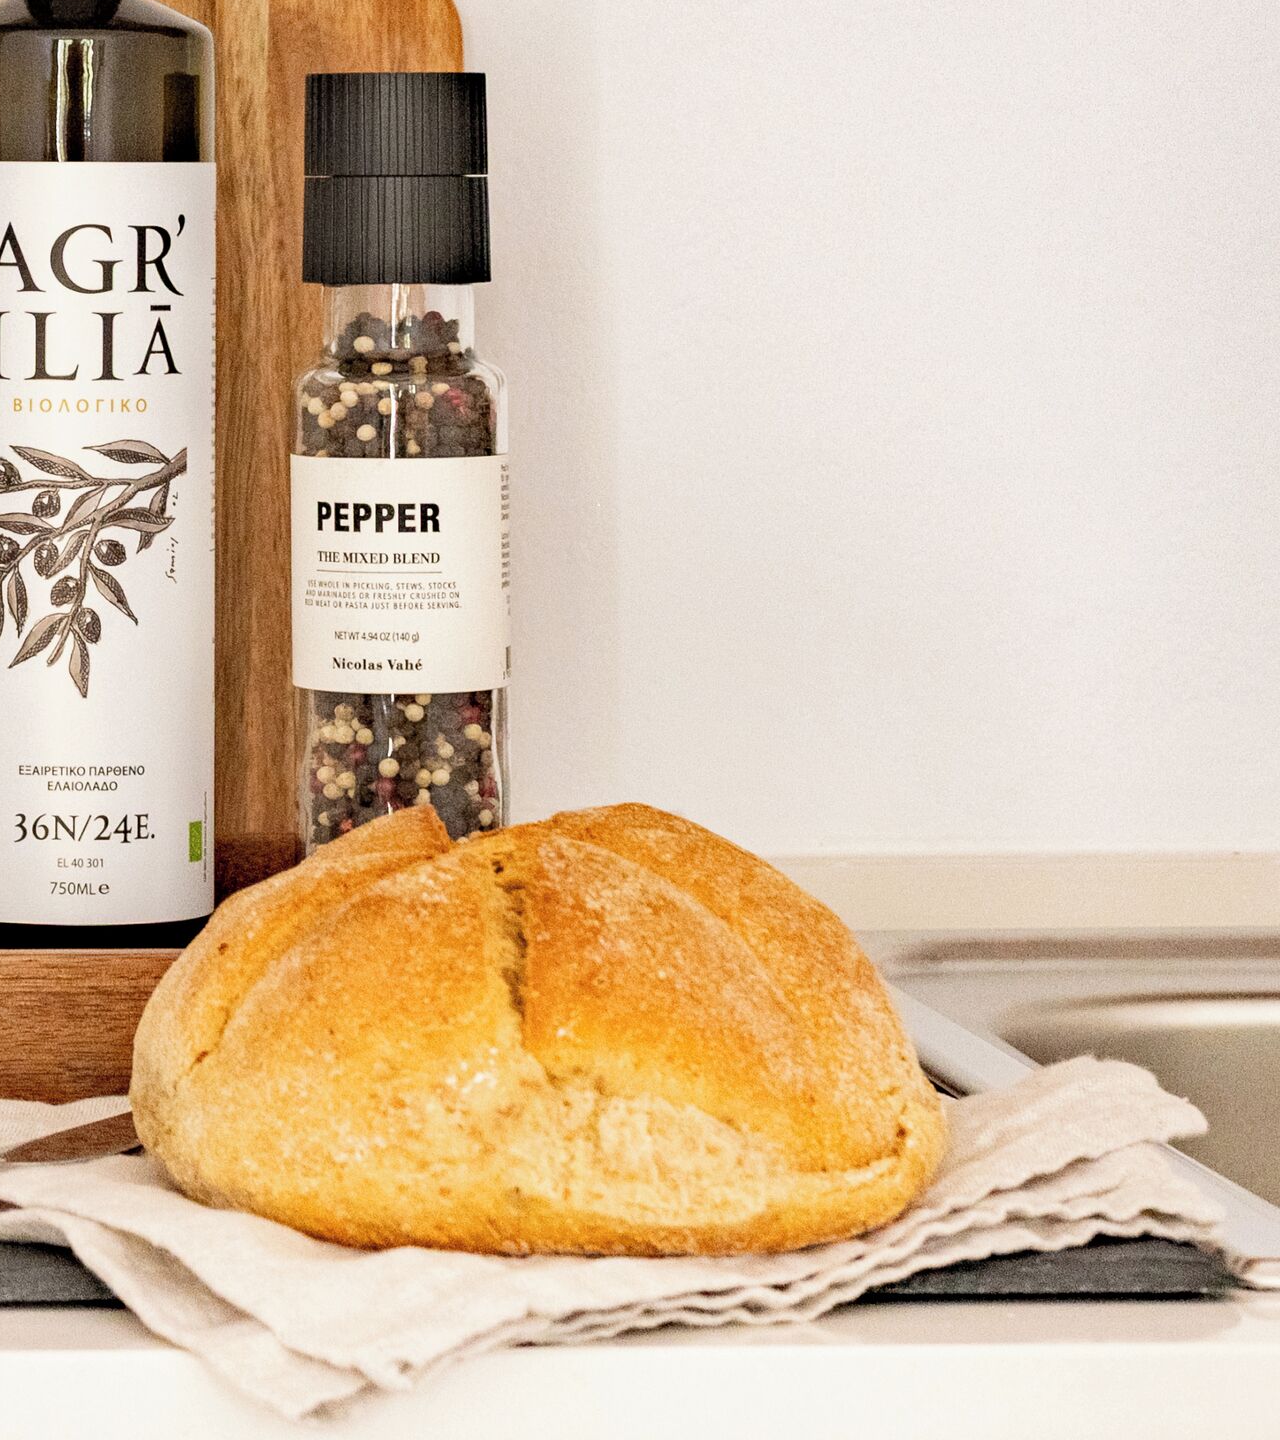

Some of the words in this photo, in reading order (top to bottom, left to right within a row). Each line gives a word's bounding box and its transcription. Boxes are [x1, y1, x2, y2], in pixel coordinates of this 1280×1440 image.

[13, 398, 148, 413] ΒΙΟΛΟΓΙΚΟ
[317, 501, 441, 533] PEPPER
[317, 550, 340, 563] THE
[343, 552, 389, 564] MIXED
[393, 552, 441, 564] BLEND
[342, 581, 351, 589] IN
[428, 581, 457, 590] STOCKS
[359, 591, 371, 599] OR
[373, 591, 406, 600] FRESHLY
[410, 591, 446, 600] CRUSHED
[449, 591, 460, 599] ON
[333, 600, 343, 608] OR
[345, 601, 368, 609] PASTA
[371, 601, 390, 610] JUST
[393, 601, 423, 610] BEFORE
[334, 631, 347, 641] NET
[347, 632, 361, 641] WT
[361, 632, 378, 642] 4.94
[379, 632, 391, 642] OZ
[392, 631, 410, 643] (140
[411, 632, 420, 644] g)
[332, 656, 383, 671] Nicolas
[387, 658, 422, 671] Vahé
[18, 764, 86, 776] ΕΞΑΙΡΕΤΙΚΟ
[89, 765, 145, 776] ΠΑΡΘΕΝΟ
[47, 781, 118, 791] ΕΛΑΙΟΛΑΔΟ
[14, 813, 155, 843] 36N/24E.
[57, 858, 69, 868] EL
[71, 858, 84, 868] 40
[86, 858, 104, 868] 301
